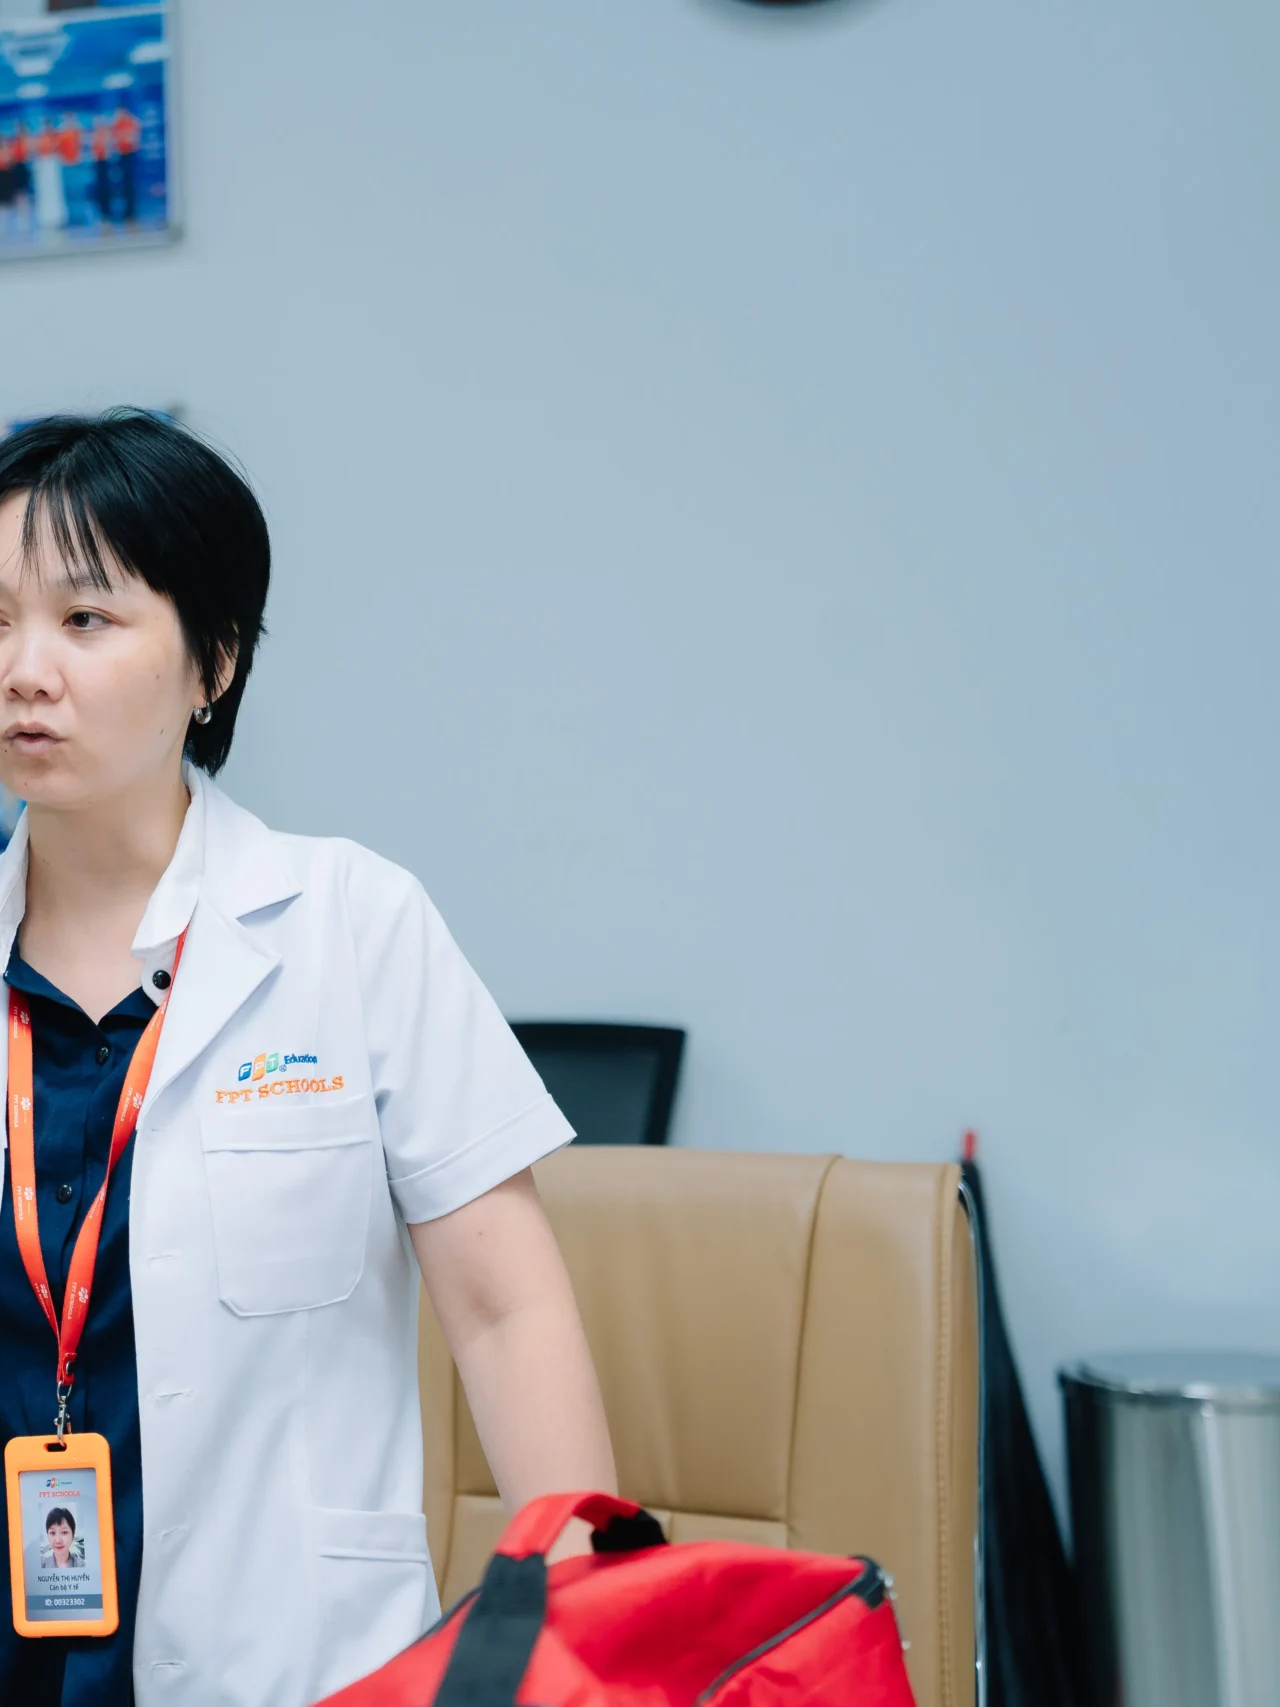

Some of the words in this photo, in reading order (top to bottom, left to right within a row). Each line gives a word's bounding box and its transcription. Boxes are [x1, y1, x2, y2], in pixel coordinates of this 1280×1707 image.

[239, 1057, 277, 1078] FPT
[215, 1088, 253, 1104] FPT
[257, 1075, 345, 1099] SCHOOLS
